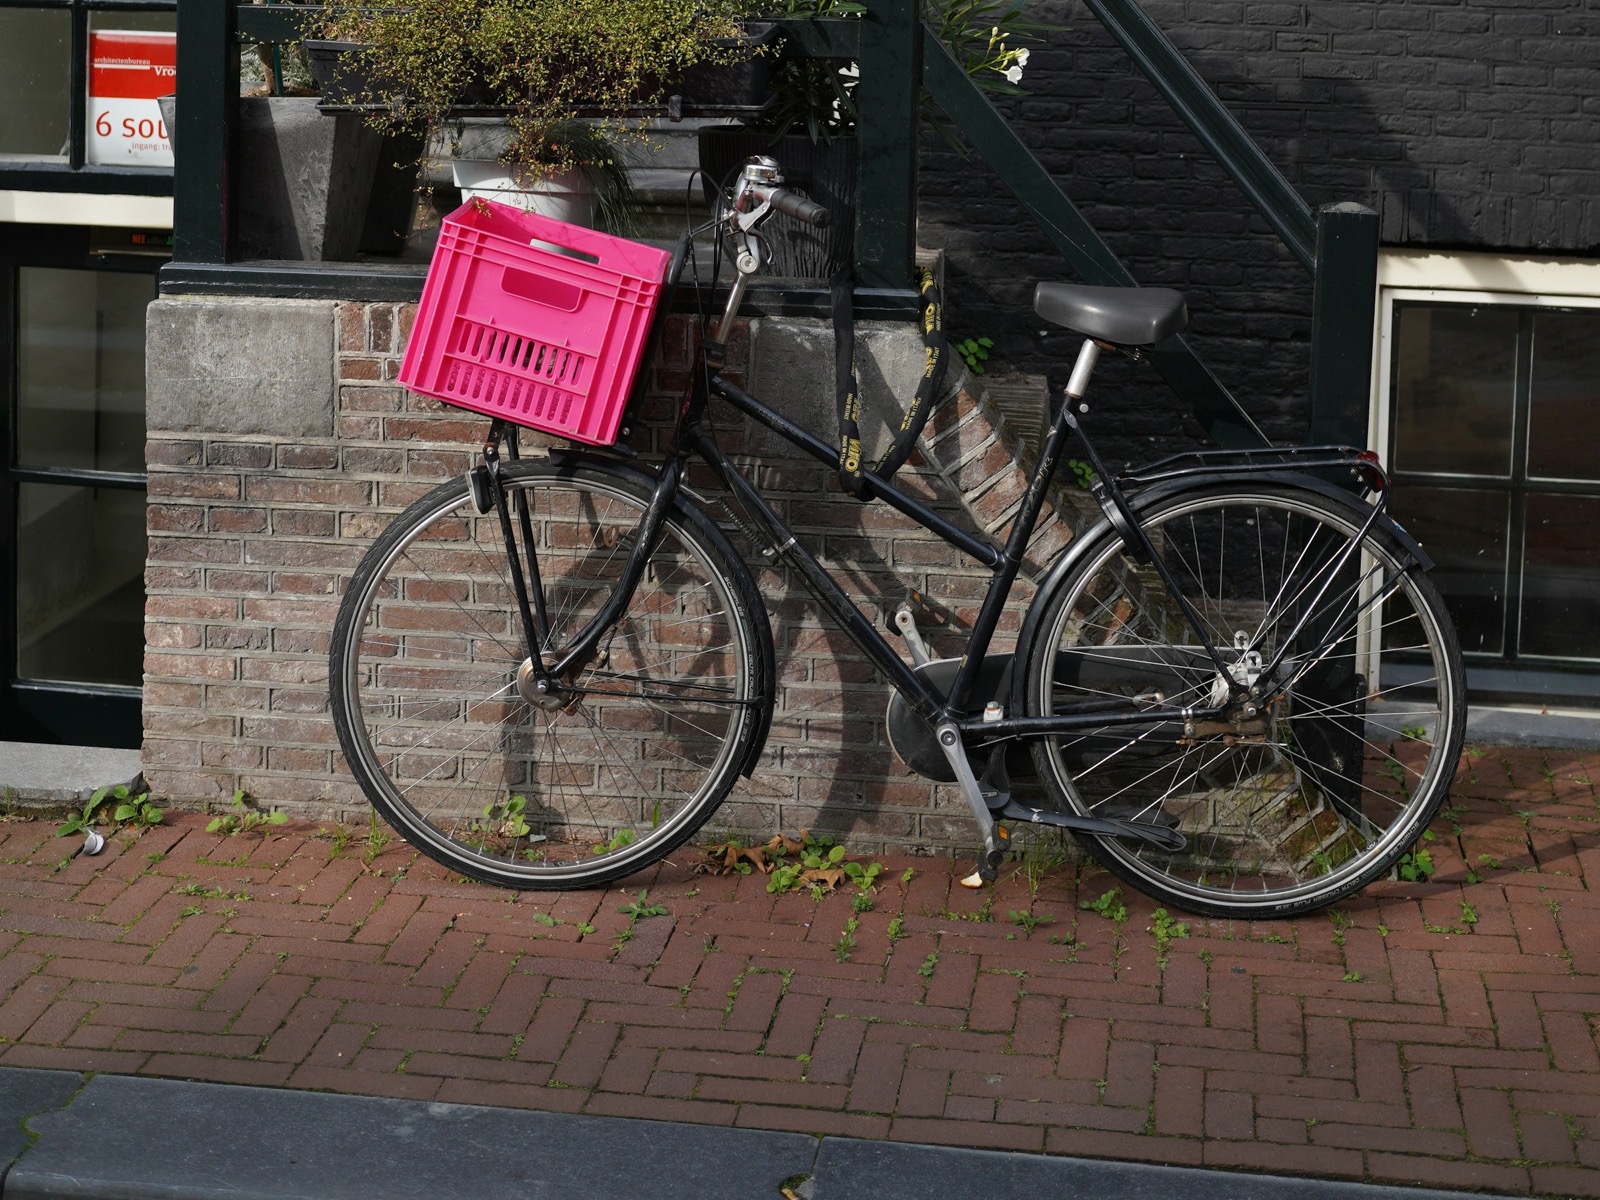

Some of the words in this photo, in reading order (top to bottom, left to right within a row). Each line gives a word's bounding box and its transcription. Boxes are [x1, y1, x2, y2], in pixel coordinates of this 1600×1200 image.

[94, 56, 151, 65] architectenbureau
[154, 66, 176, 76] Vro
[95, 111, 112, 137] 6
[132, 142, 160, 152] ingang:
[131, 233, 146, 245] NEE
[723, 576, 745, 617] SCHWALBE
[1389, 821, 1420, 857] SCHWALBE
[1341, 877, 1360, 891] DELTA
[1313, 888, 1340, 902] CRUISER
[1293, 899, 1311, 908] PLUS
